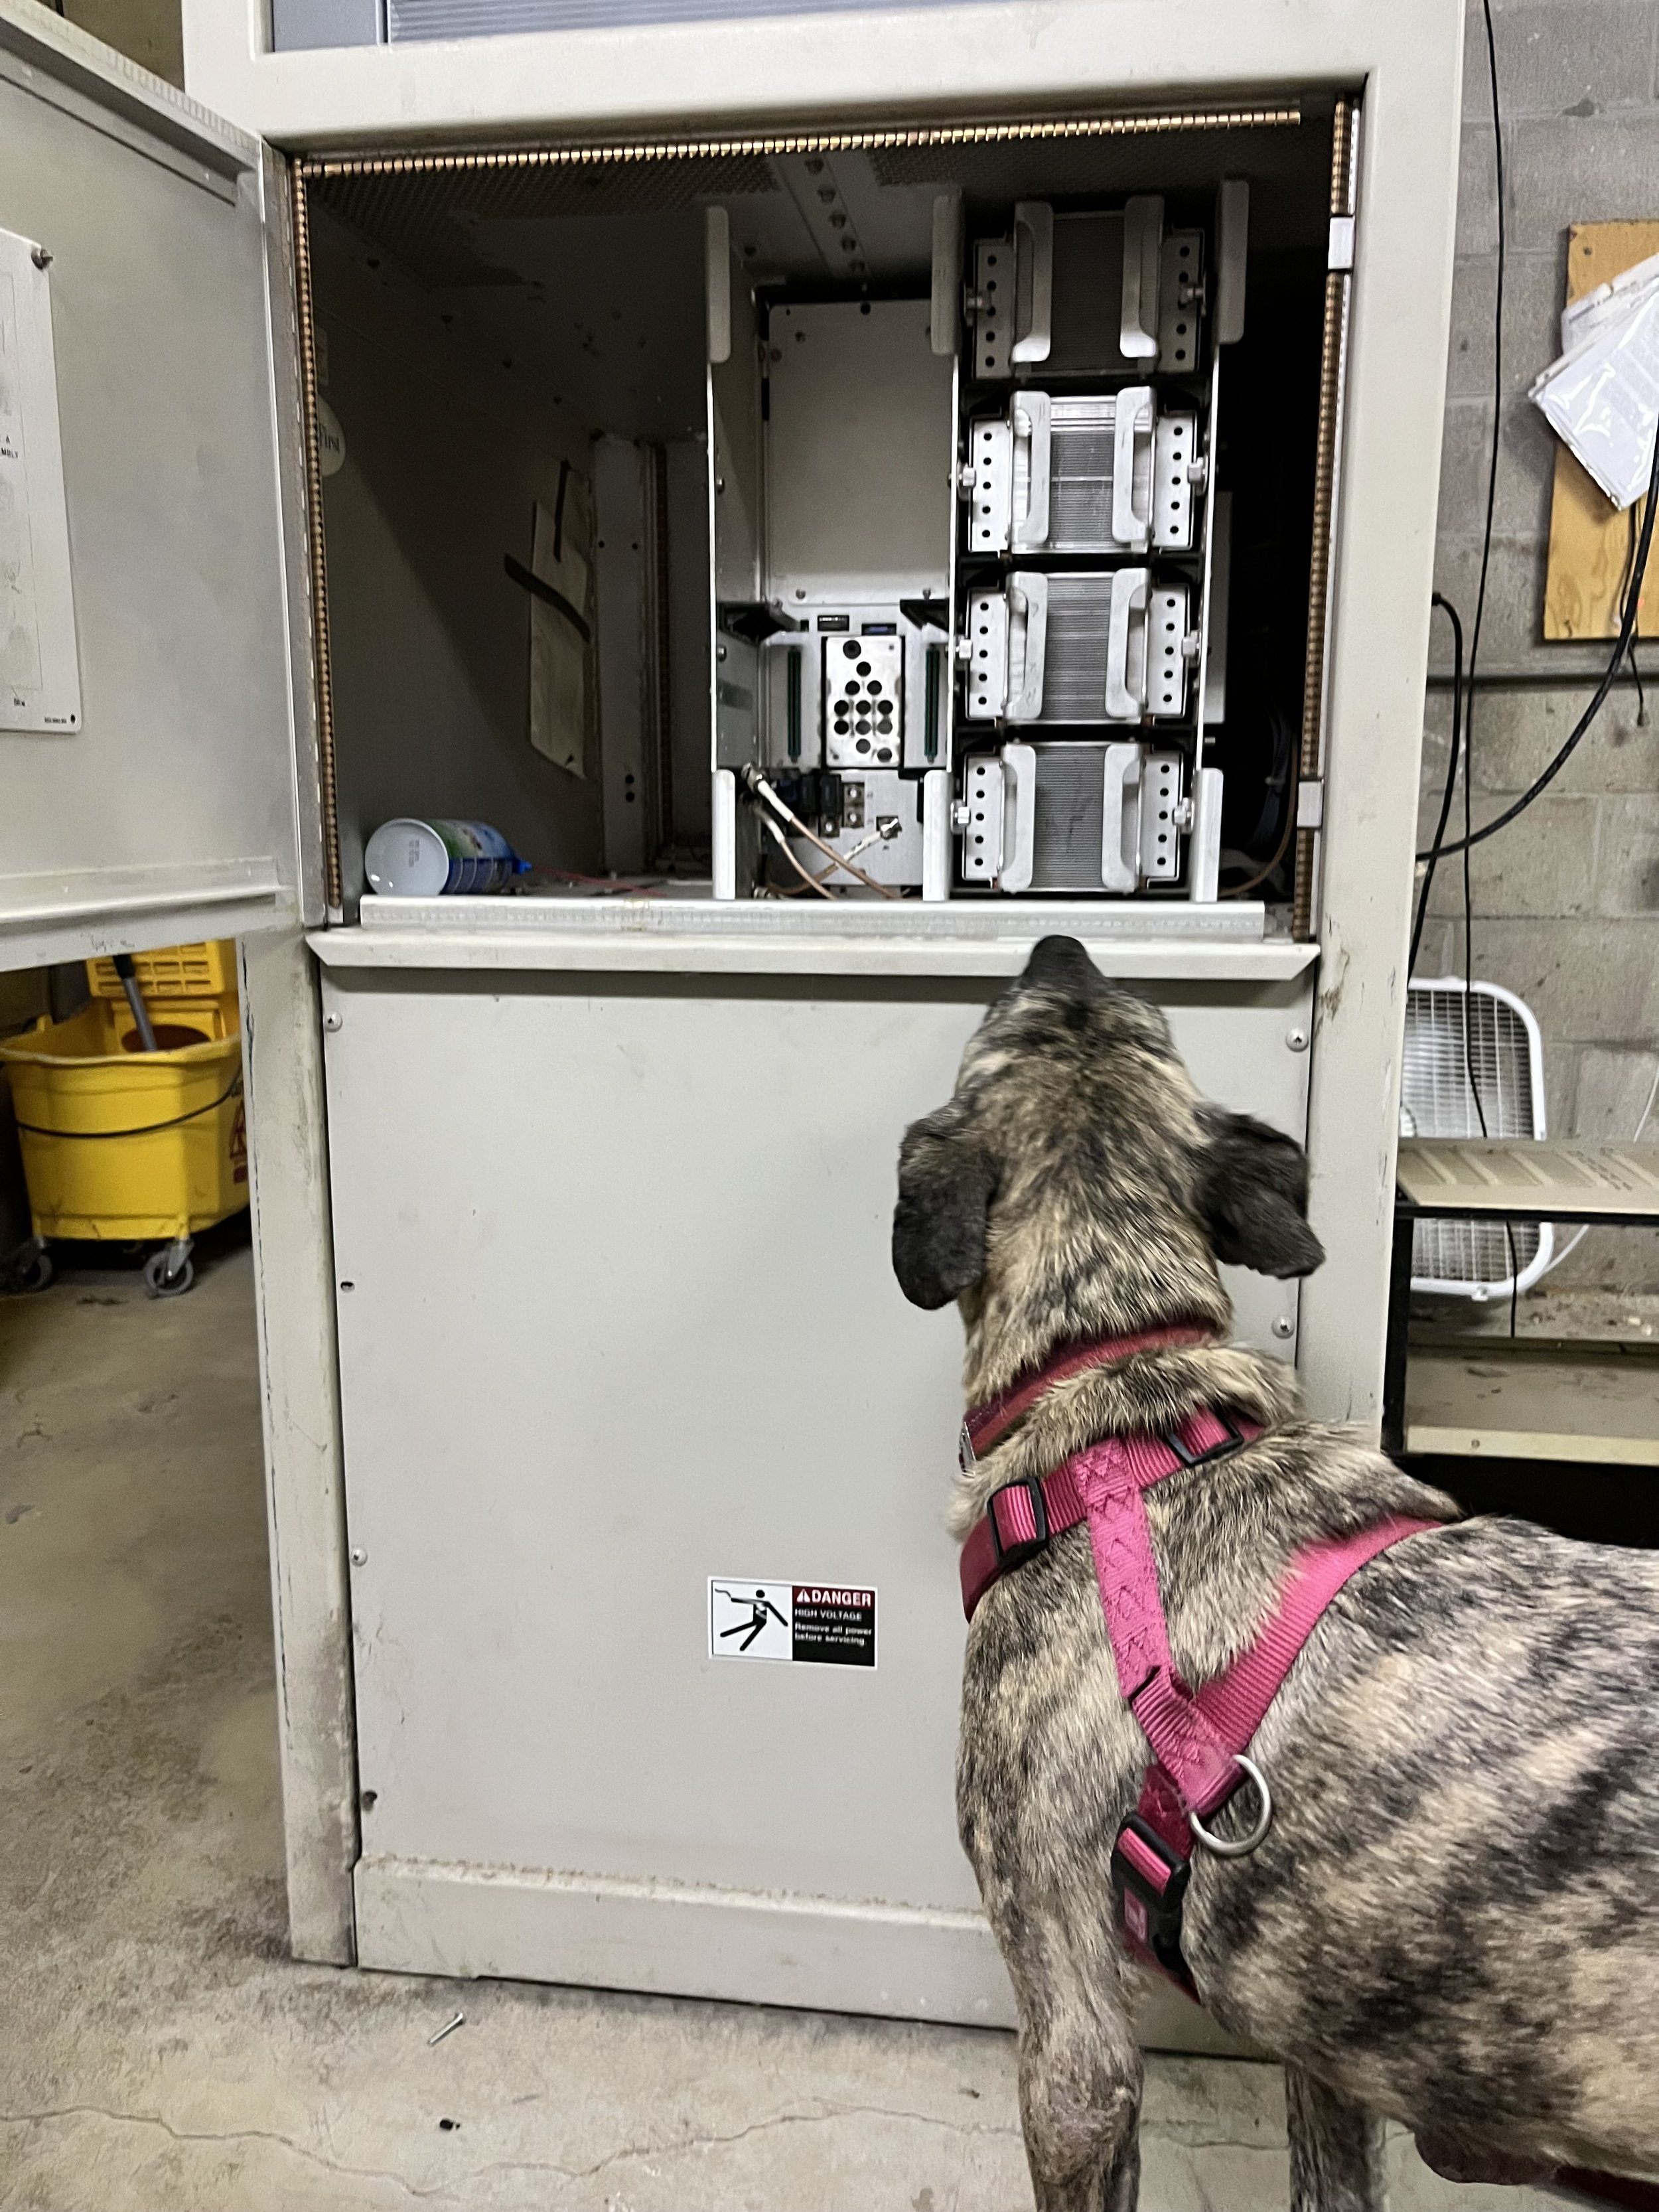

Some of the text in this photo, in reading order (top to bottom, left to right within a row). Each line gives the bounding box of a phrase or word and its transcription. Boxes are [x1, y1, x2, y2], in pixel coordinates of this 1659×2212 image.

[812, 1589, 871, 1607] DANGER
[794, 1609, 863, 1621] HIGH VOLTAGE
[794, 1621, 872, 1637] Remove all power
[794, 1632, 823, 1642] before
